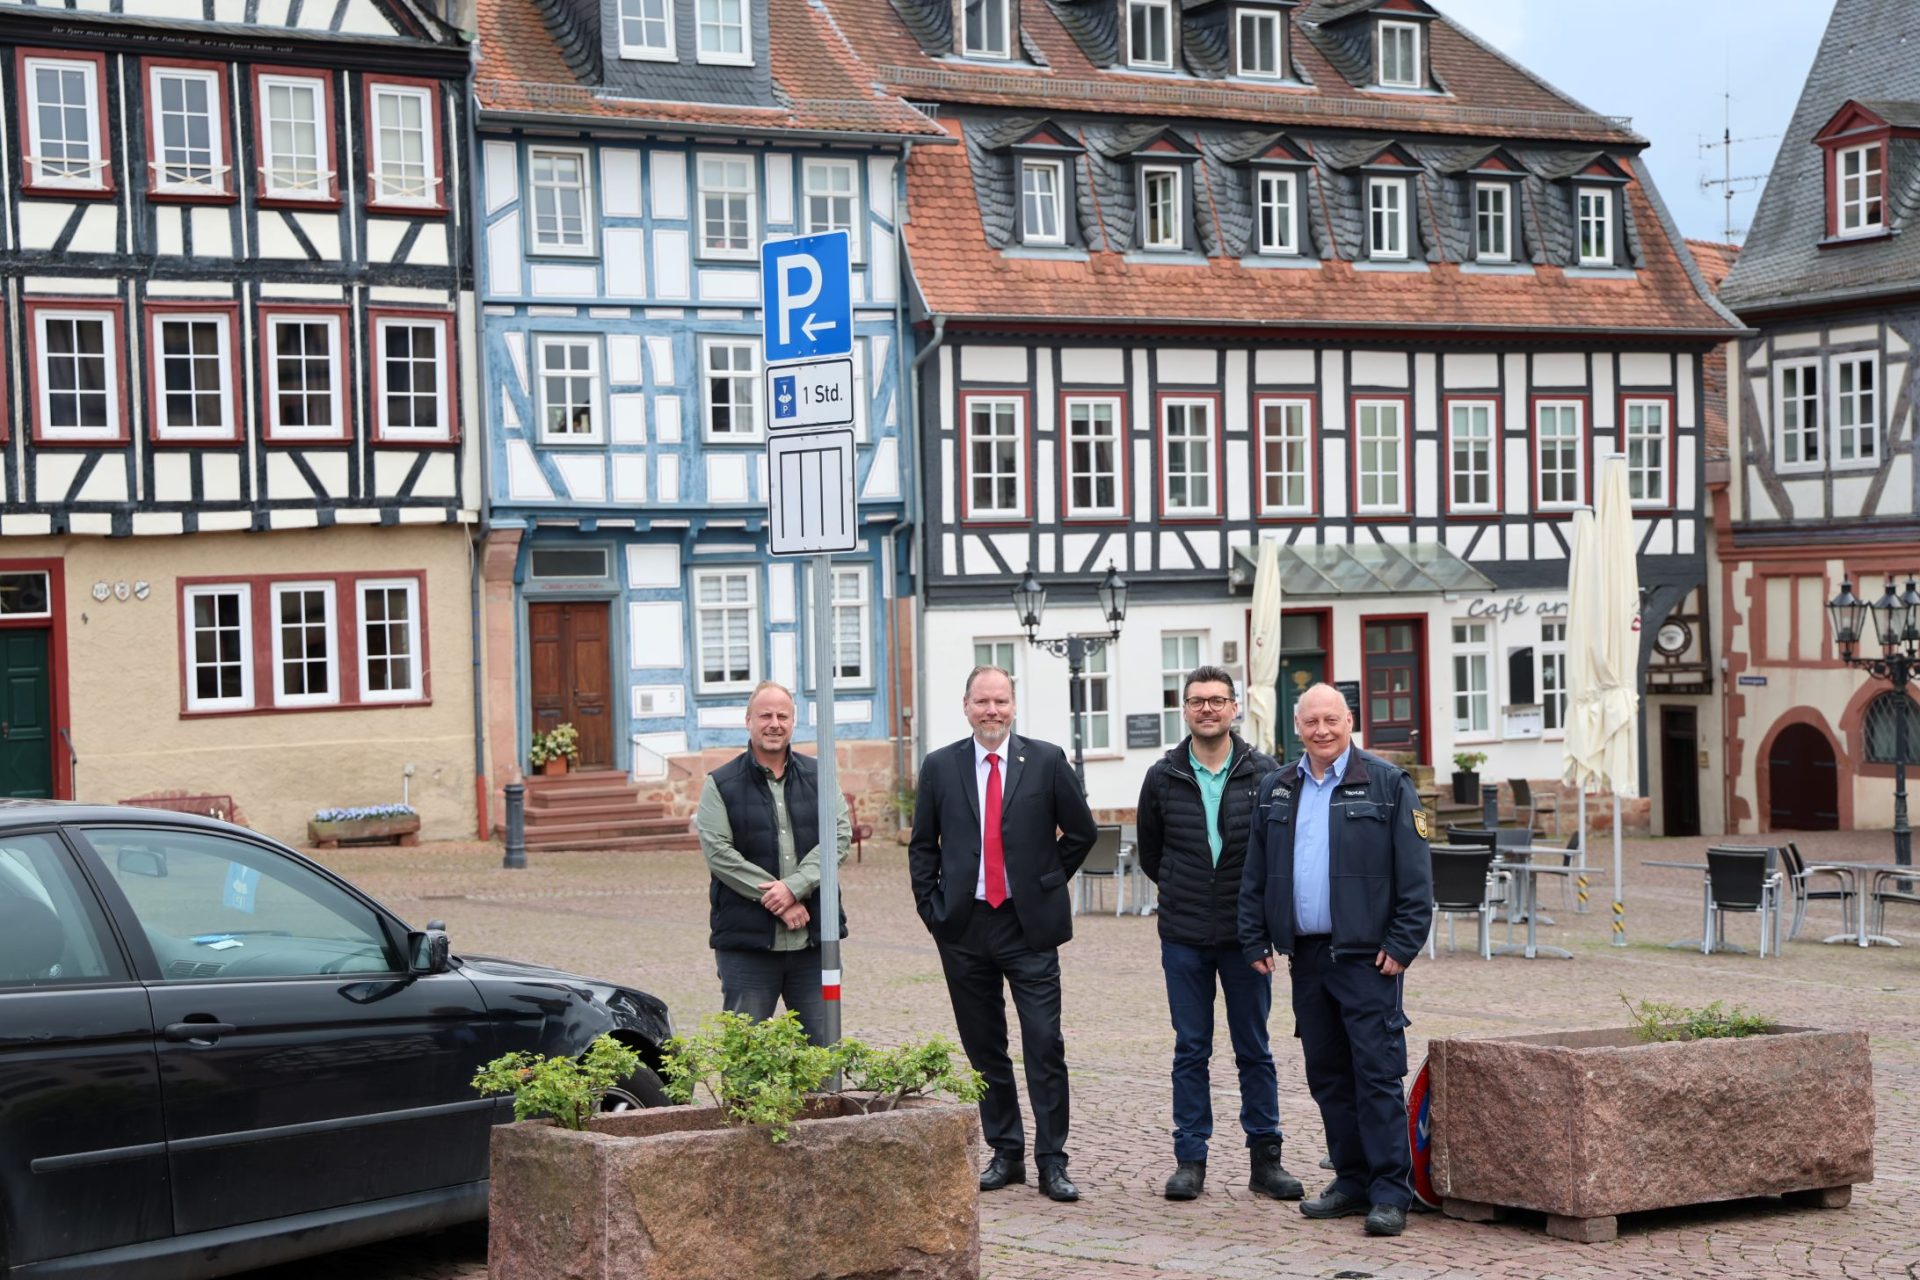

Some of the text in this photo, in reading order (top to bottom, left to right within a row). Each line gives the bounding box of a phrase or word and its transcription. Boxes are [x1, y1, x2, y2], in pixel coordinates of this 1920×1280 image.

[777, 253, 823, 345] P
[803, 383, 843, 405] 1 Std.
[1467, 594, 1529, 623] Café
